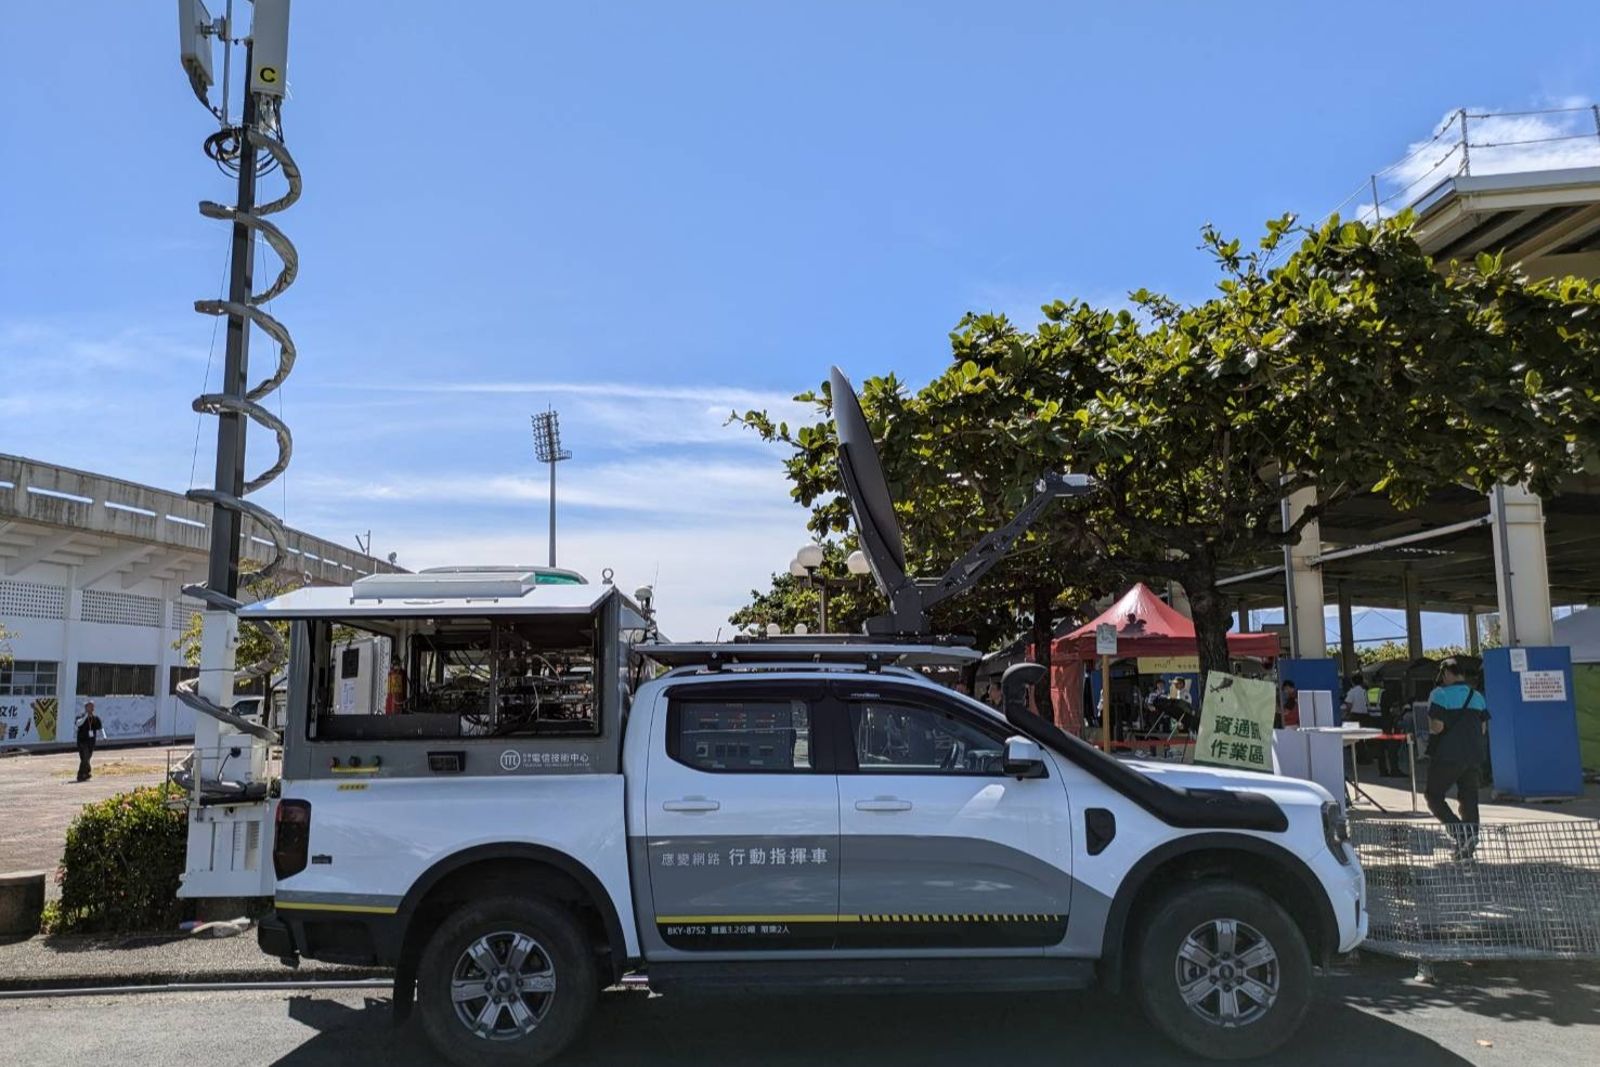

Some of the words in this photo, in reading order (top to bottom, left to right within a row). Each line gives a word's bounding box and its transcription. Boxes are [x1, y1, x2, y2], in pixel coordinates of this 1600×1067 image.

[259, 67, 276, 83] C
[1210, 739, 1264, 764] 作業區
[661, 852, 720, 867] 應變網路
[728, 847, 828, 867] 行動指揮車
